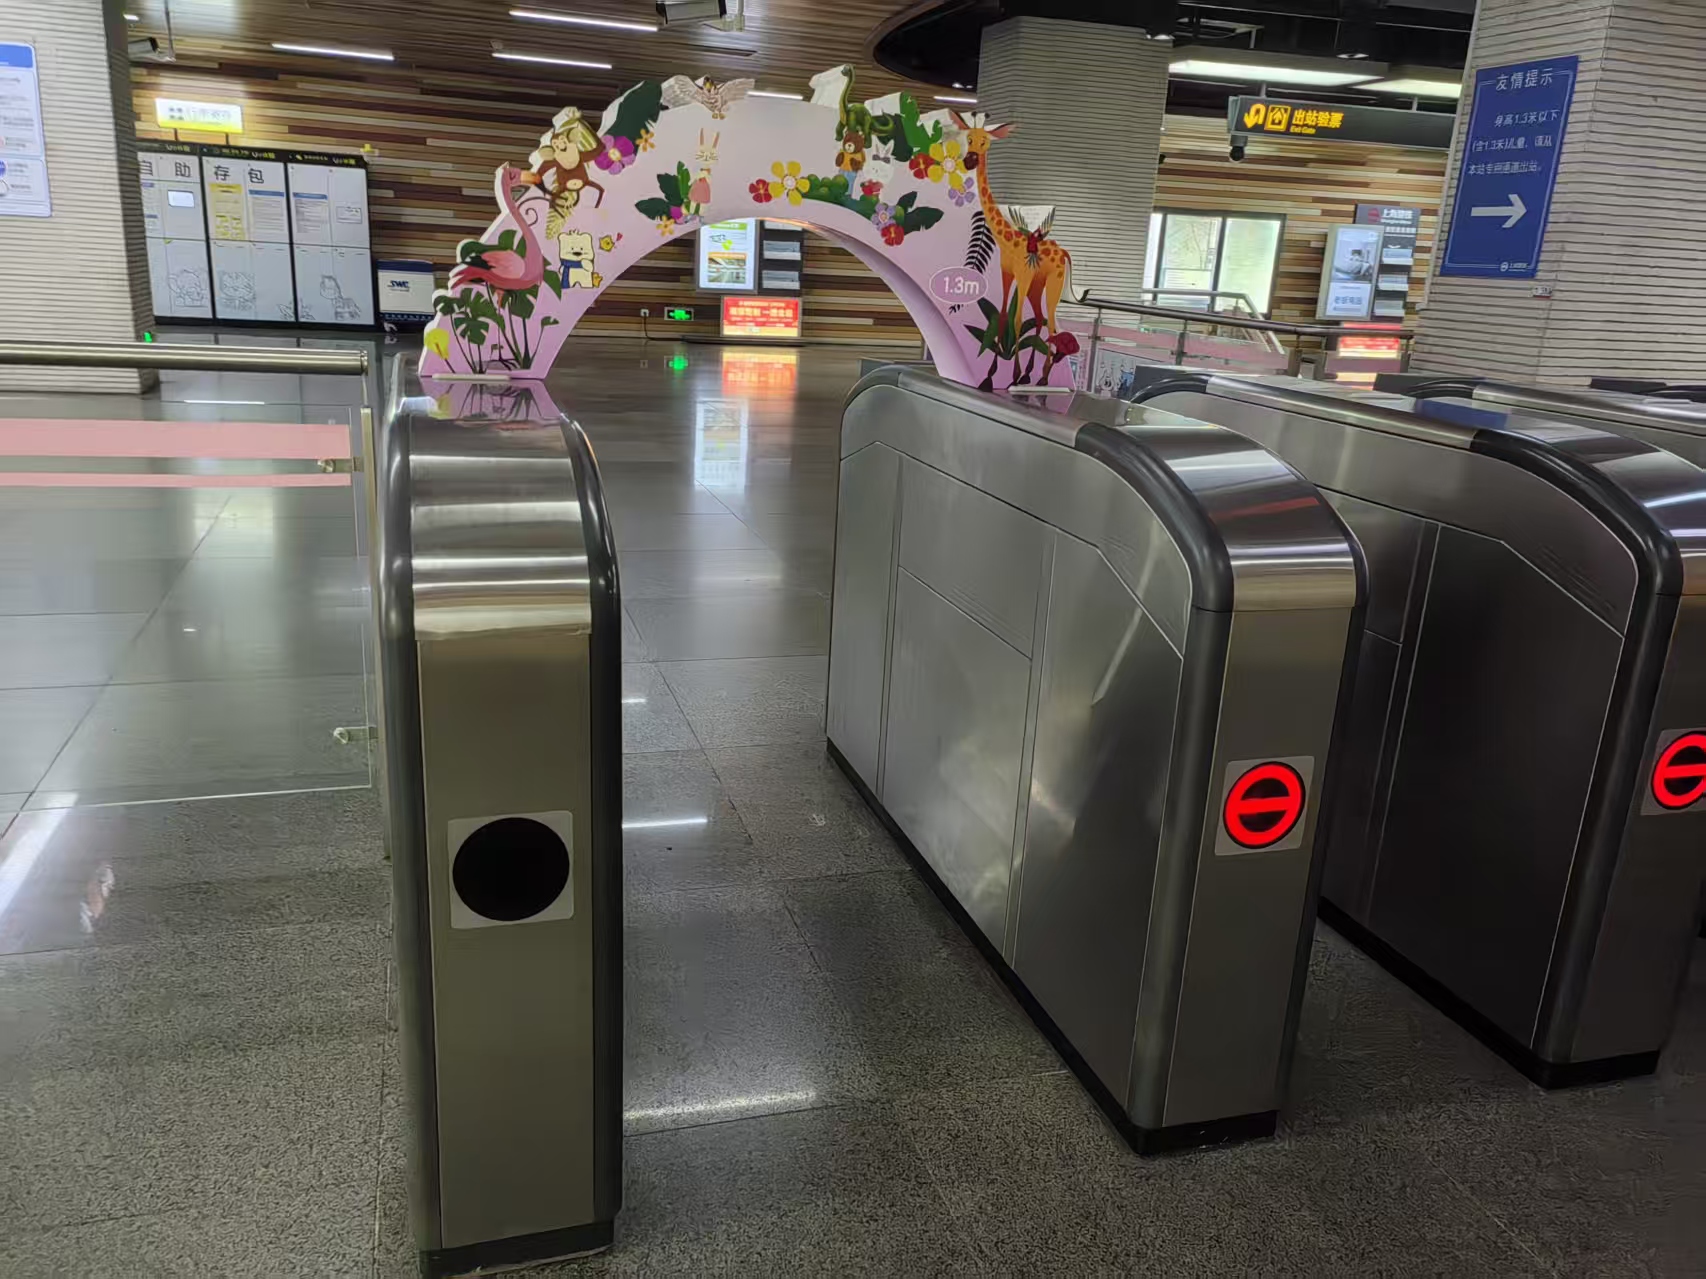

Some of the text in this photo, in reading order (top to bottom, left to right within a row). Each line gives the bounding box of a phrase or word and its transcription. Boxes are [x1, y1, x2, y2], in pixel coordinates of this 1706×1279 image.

[1496, 68, 1553, 91] 友情提示
[1292, 109, 1344, 128] 出站验票
[1495, 109, 1560, 127] 身高1.3米以下
[943, 276, 980, 296] 1.3m
